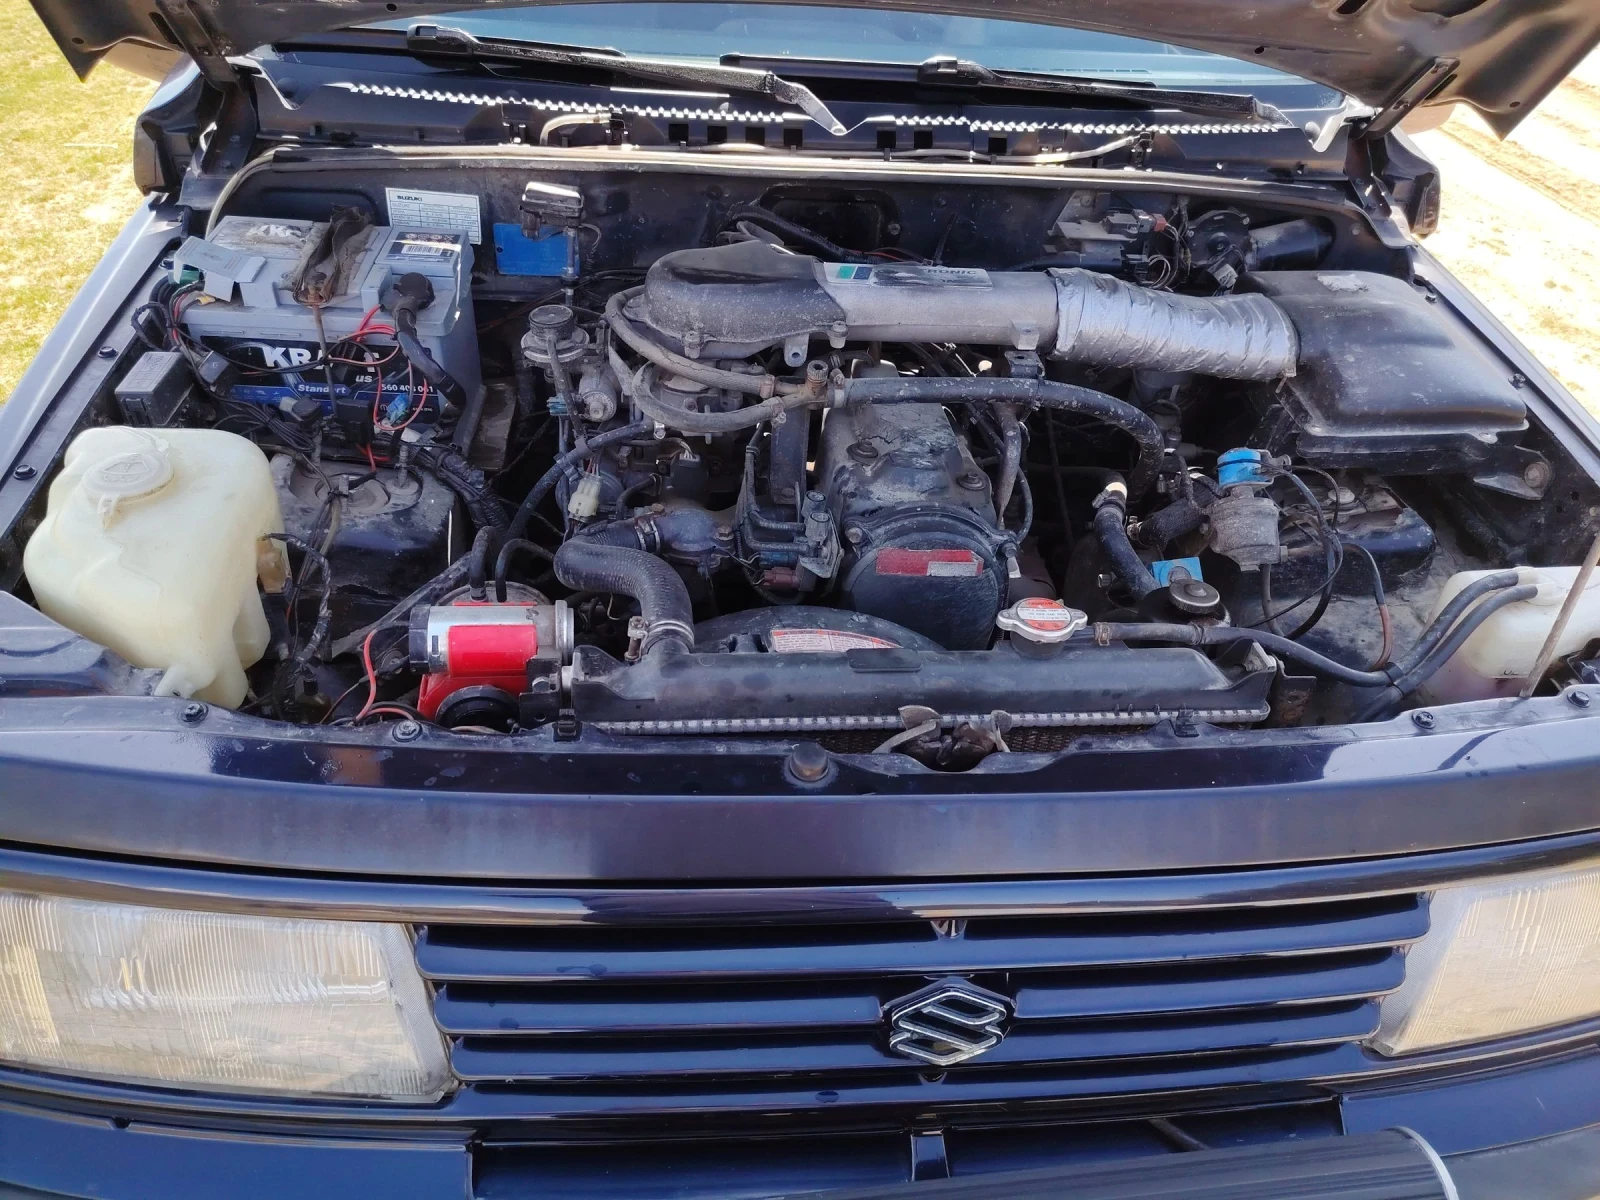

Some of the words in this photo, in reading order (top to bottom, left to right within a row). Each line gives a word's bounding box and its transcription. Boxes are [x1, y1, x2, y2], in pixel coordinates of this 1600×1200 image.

[261, 346, 381, 373] KRT
[297, 384, 347, 394] Standrt
[381, 383, 398, 391] 560
[417, 385, 434, 393] 01
